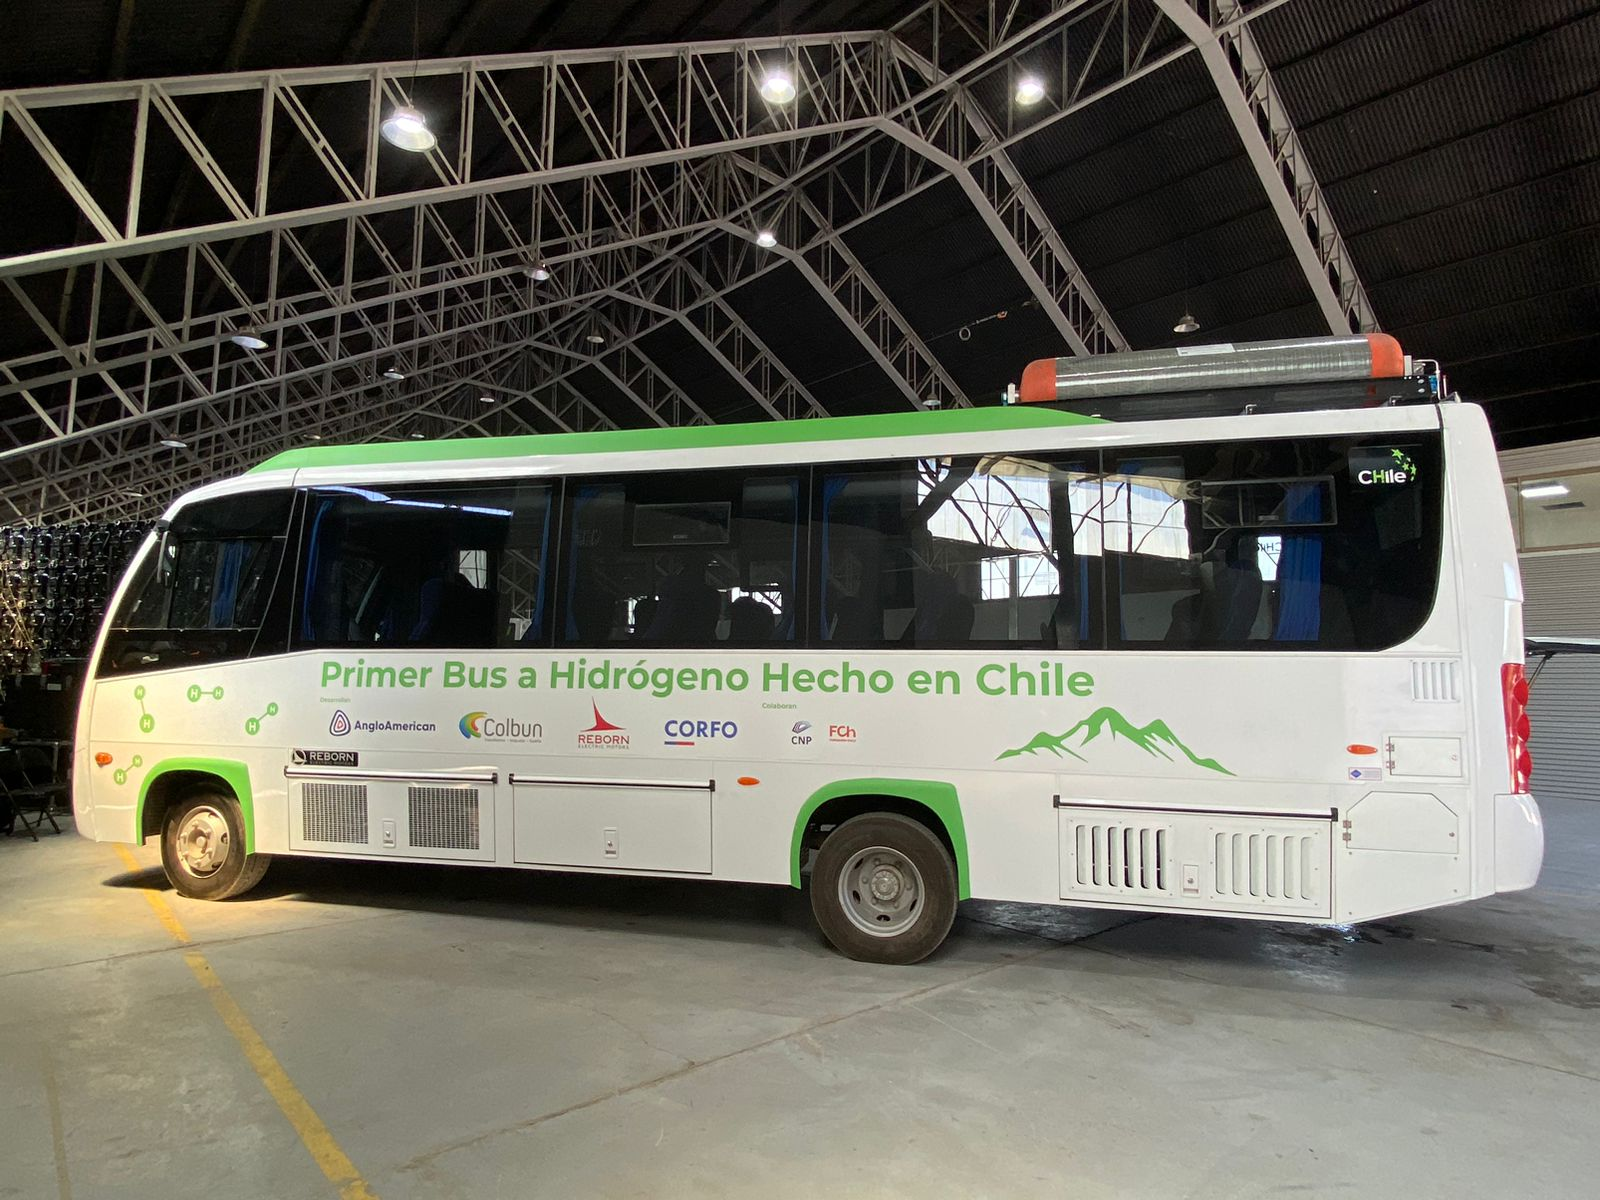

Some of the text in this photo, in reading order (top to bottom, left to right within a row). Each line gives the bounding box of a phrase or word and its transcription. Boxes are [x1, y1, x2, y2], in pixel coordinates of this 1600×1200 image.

[321, 659, 1094, 697] Primer Bus a Hidrógeno Hecho en Chile
[136, 688, 142, 697] H
[190, 689, 198, 698] H
[144, 719, 151, 728] H
[249, 722, 256, 731] H
[354, 720, 436, 733] AngloAmerican
[484, 718, 542, 737] Colbun
[664, 720, 738, 739] CORFO
[829, 725, 857, 738] FCh
[578, 734, 630, 745] REBORN
[791, 735, 812, 745] CNP
[309, 751, 355, 762] REBORN
[116, 773, 123, 782] H
